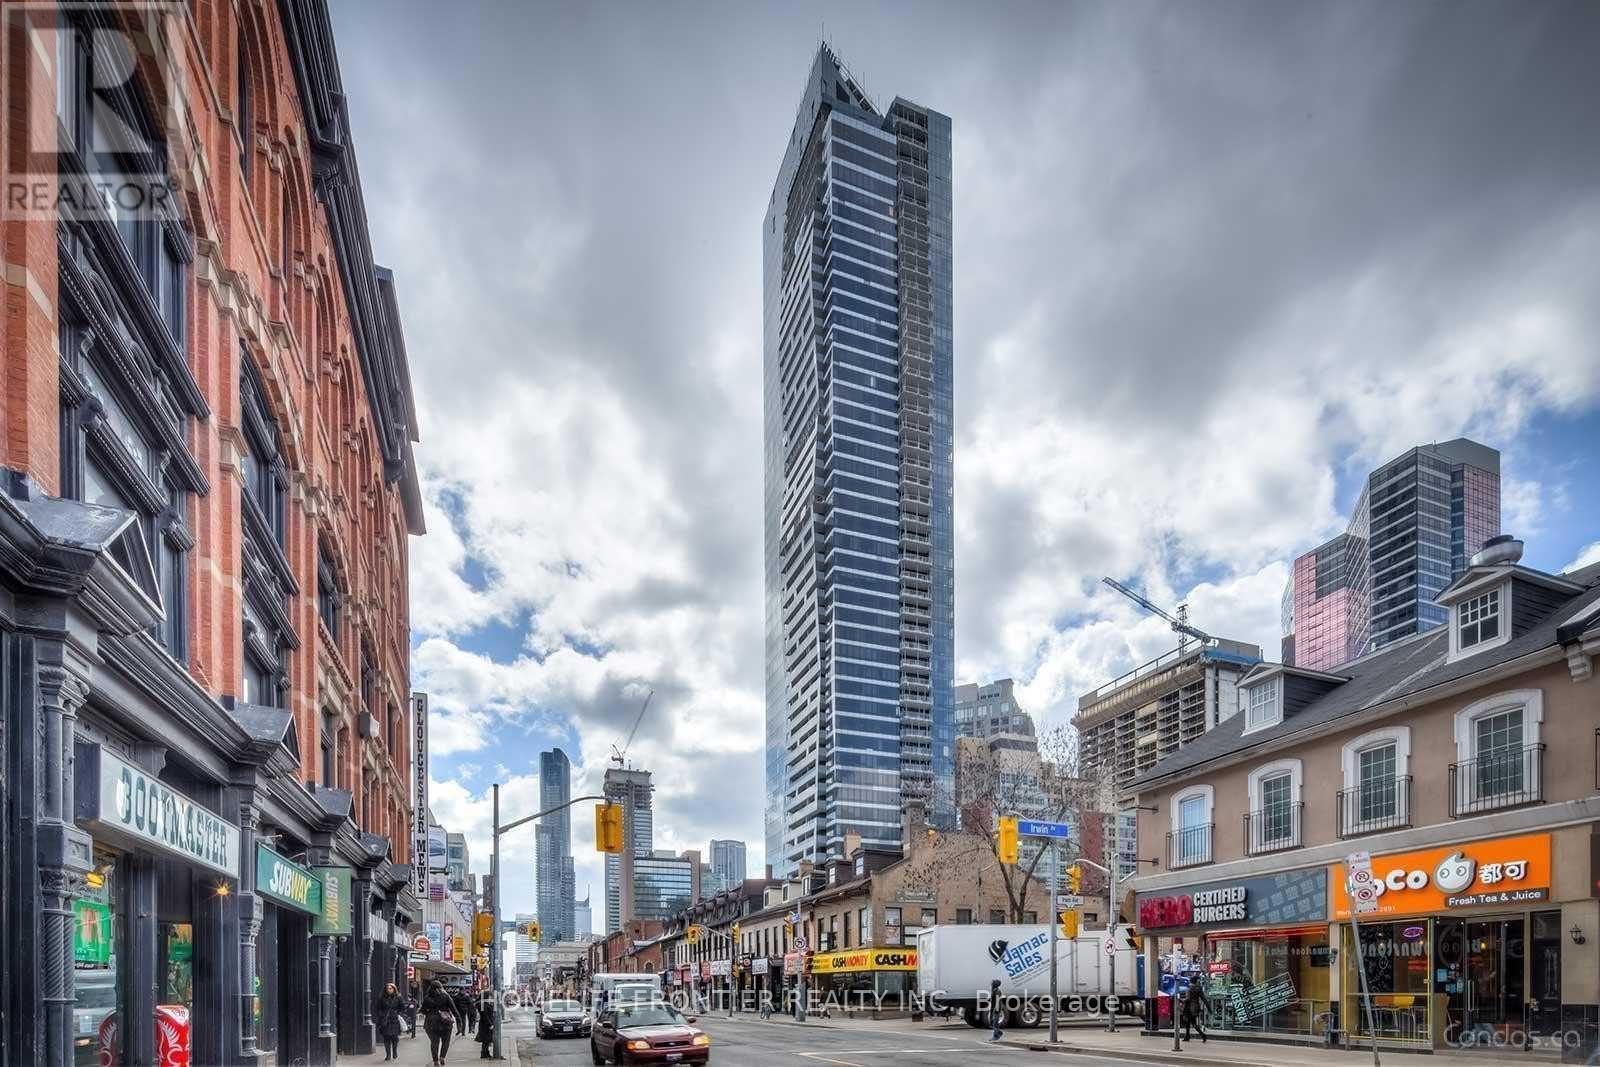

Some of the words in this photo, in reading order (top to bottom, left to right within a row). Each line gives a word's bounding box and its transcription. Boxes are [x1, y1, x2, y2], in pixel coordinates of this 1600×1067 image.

[416, 699, 426, 834] GLOUCESTER
[1030, 823, 1049, 835] Irwin
[416, 839, 427, 894] MEWS
[1479, 860, 1528, 884] 都可
[269, 860, 312, 905] SUBWAY
[325, 871, 339, 931] SUBWAY
[1193, 886, 1247, 907] CERTIFIED
[1448, 895, 1477, 907] Fresh
[1480, 894, 1498, 904] Tea
[1500, 892, 1509, 901] &
[1512, 889, 1542, 901] Juice
[1193, 902, 1246, 924] BURGERS
[1005, 951, 1043, 977] Sales
